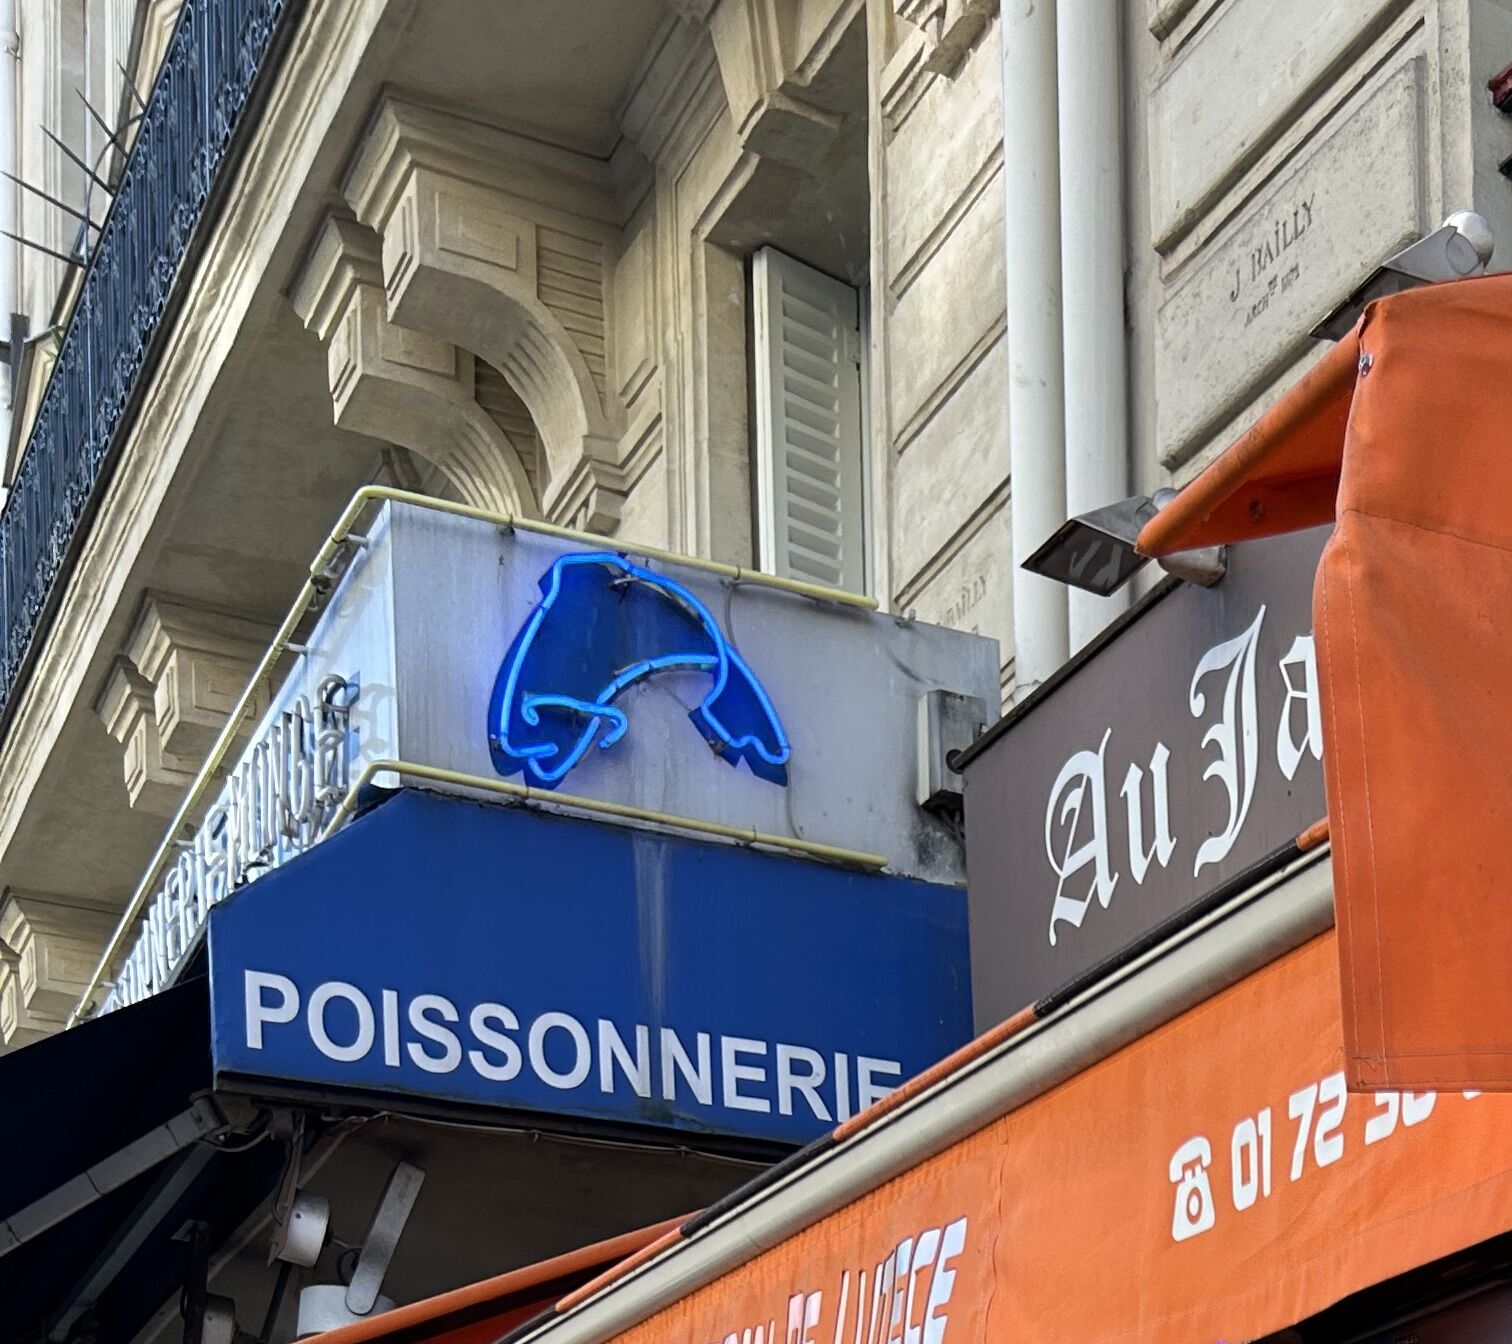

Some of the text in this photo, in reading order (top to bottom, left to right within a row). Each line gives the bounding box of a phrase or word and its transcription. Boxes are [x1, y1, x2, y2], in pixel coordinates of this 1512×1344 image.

[1046, 728, 1177, 946] Au
[244, 969, 902, 1124] POISSONNERIE
[1231, 1070, 1348, 1212] 01 72
